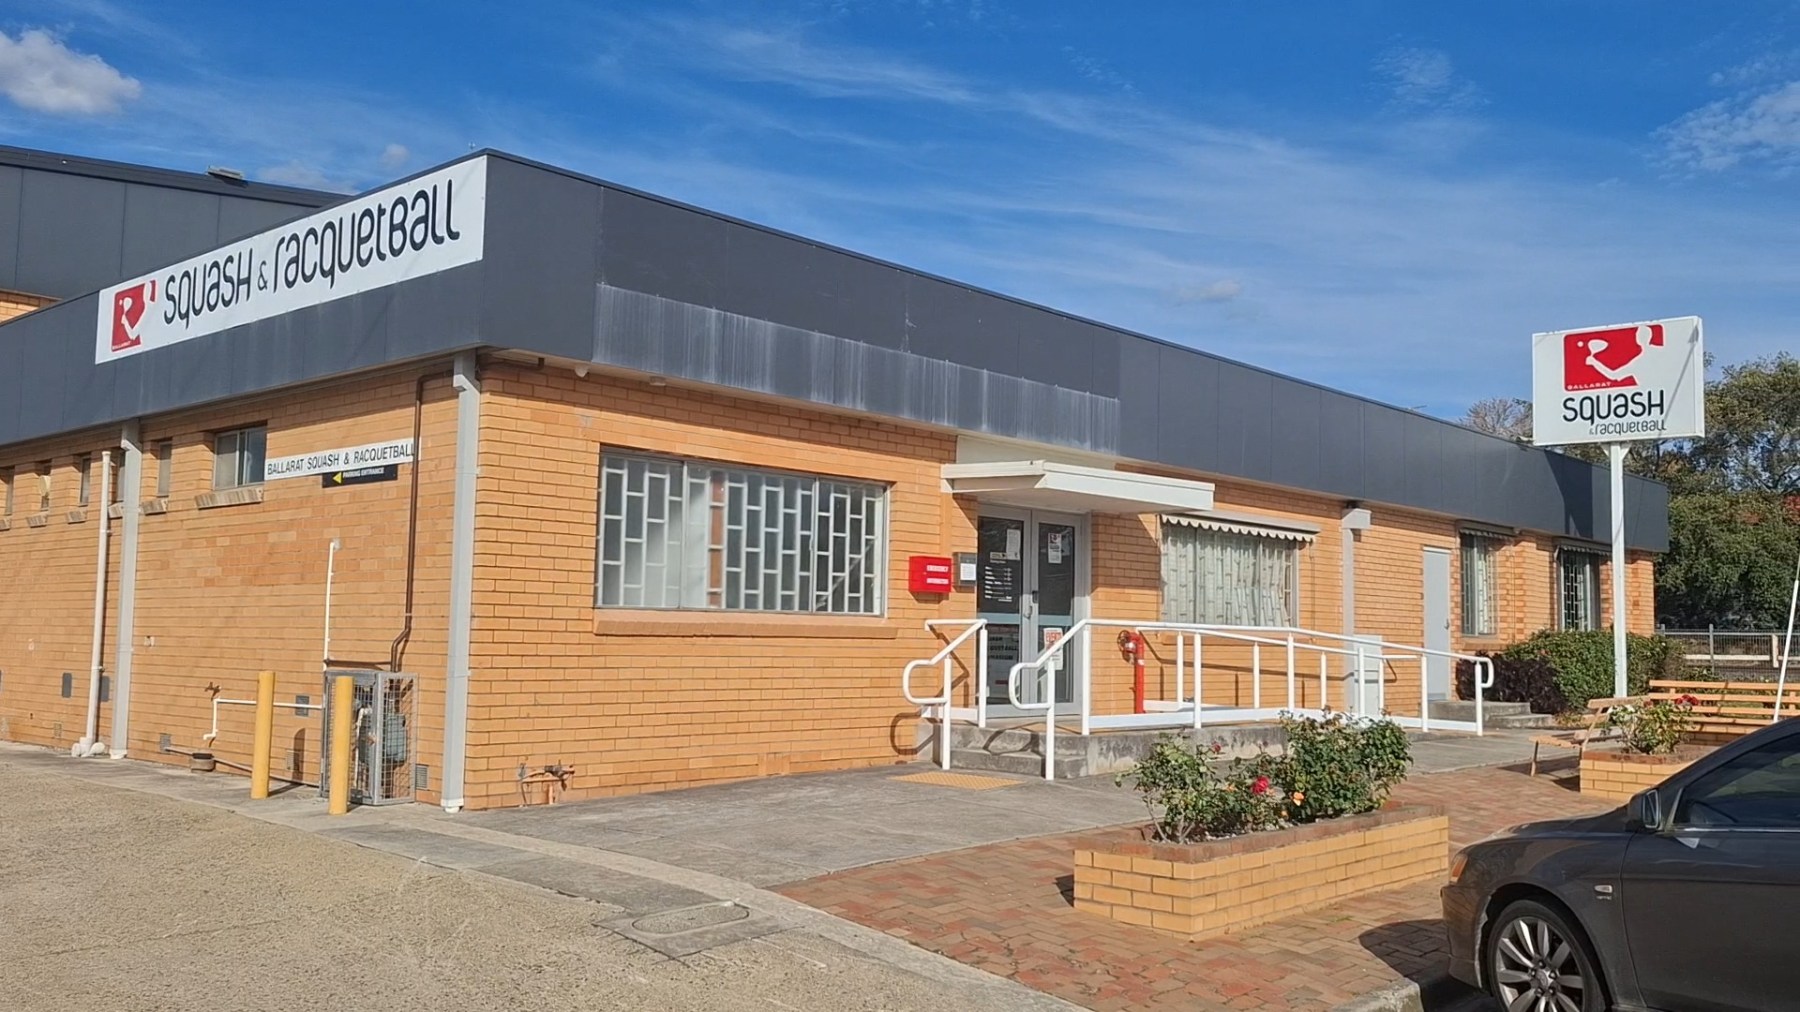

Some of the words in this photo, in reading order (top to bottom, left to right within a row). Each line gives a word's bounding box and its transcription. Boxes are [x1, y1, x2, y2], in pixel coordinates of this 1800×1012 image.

[257, 259, 268, 291] &
[267, 459, 305, 476] BALLARAT
[306, 453, 340, 470] SQUASH
[343, 452, 350, 465] &
[353, 443, 415, 464] RACQUETBALL
